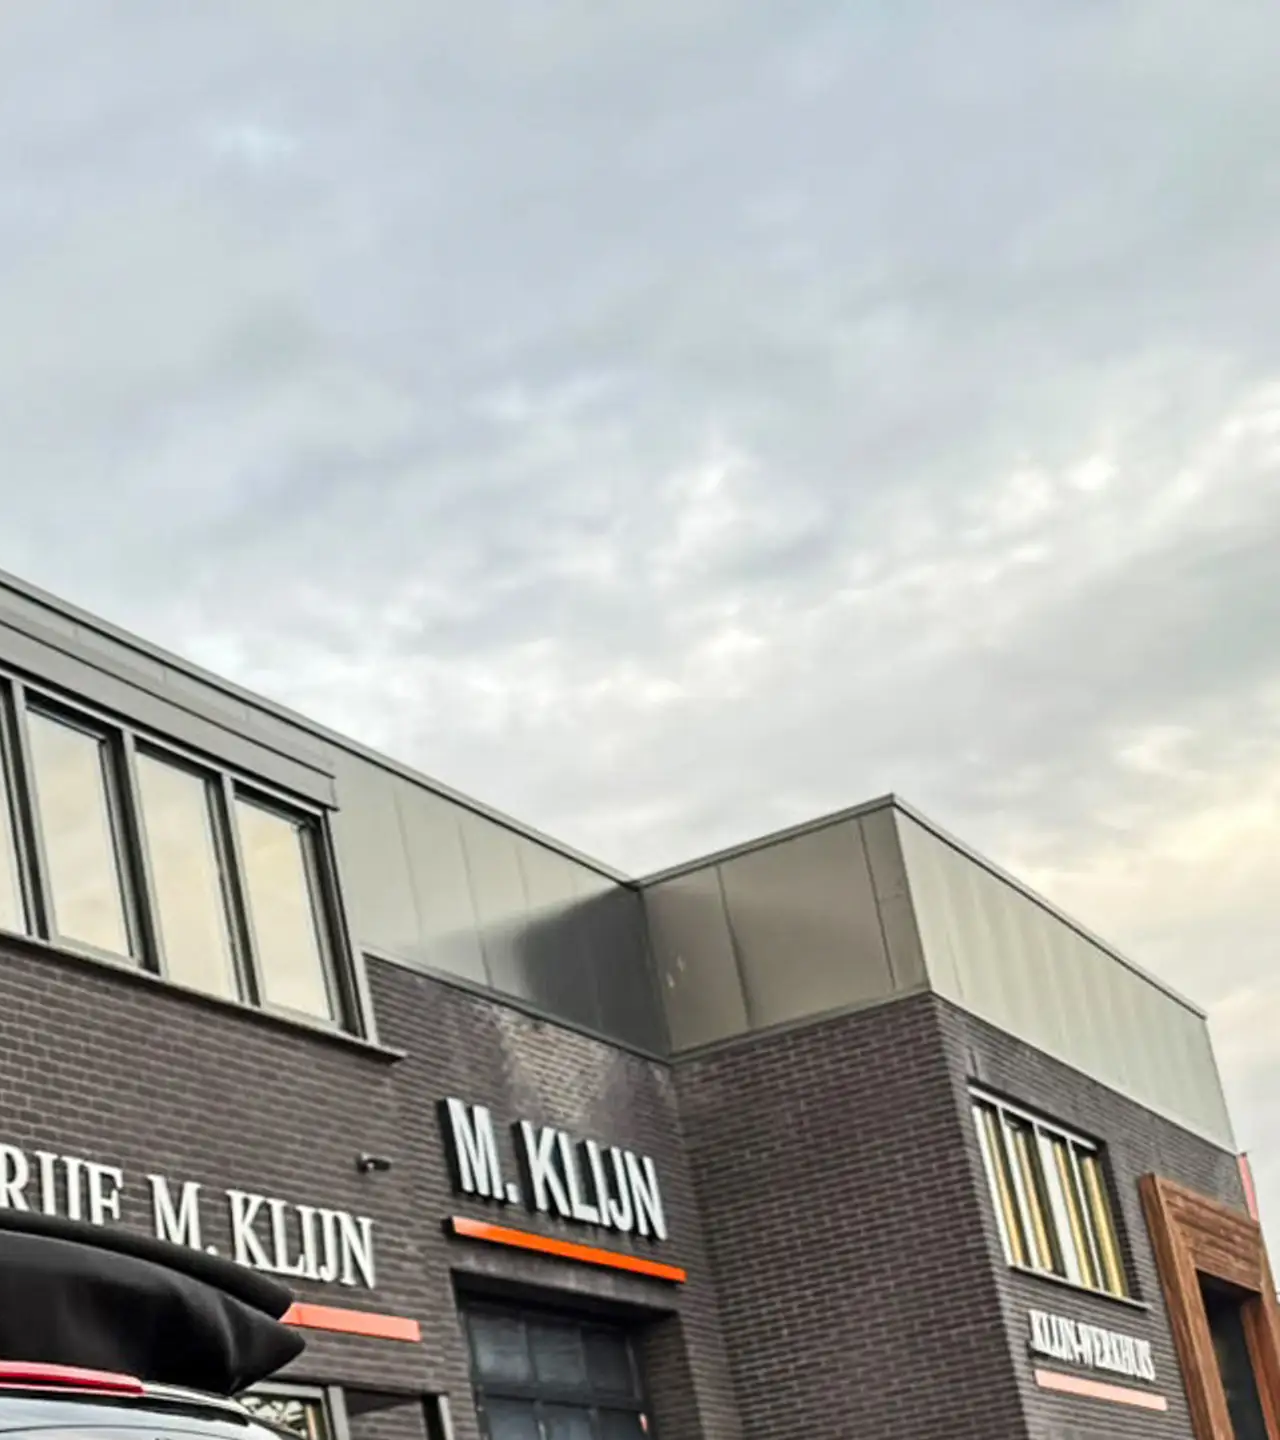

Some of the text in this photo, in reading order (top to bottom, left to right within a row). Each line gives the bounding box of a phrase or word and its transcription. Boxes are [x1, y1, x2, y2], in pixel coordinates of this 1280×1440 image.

[147, 1174, 218, 1256] M.
[226, 1189, 375, 1289] KLIJN
[445, 1096, 668, 1240] M. KLIJN
